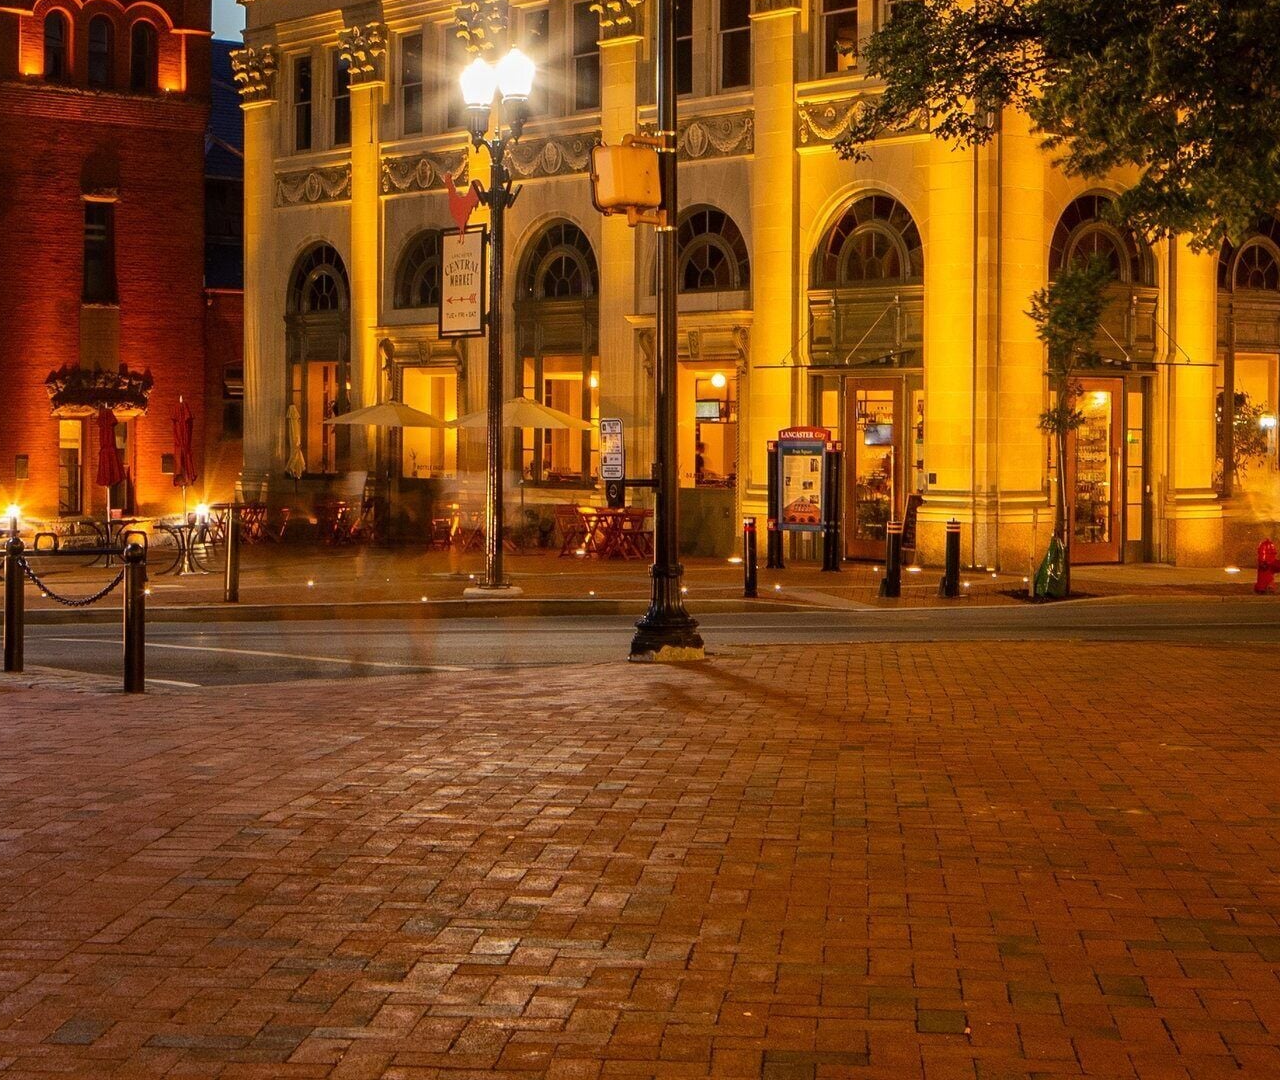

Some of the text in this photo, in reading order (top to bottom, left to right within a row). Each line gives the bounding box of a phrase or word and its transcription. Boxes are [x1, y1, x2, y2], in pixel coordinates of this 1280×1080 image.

[444, 259, 479, 277] CENTRAL
[450, 273, 474, 287] MARKET
[780, 431, 813, 439] LANCASTER
